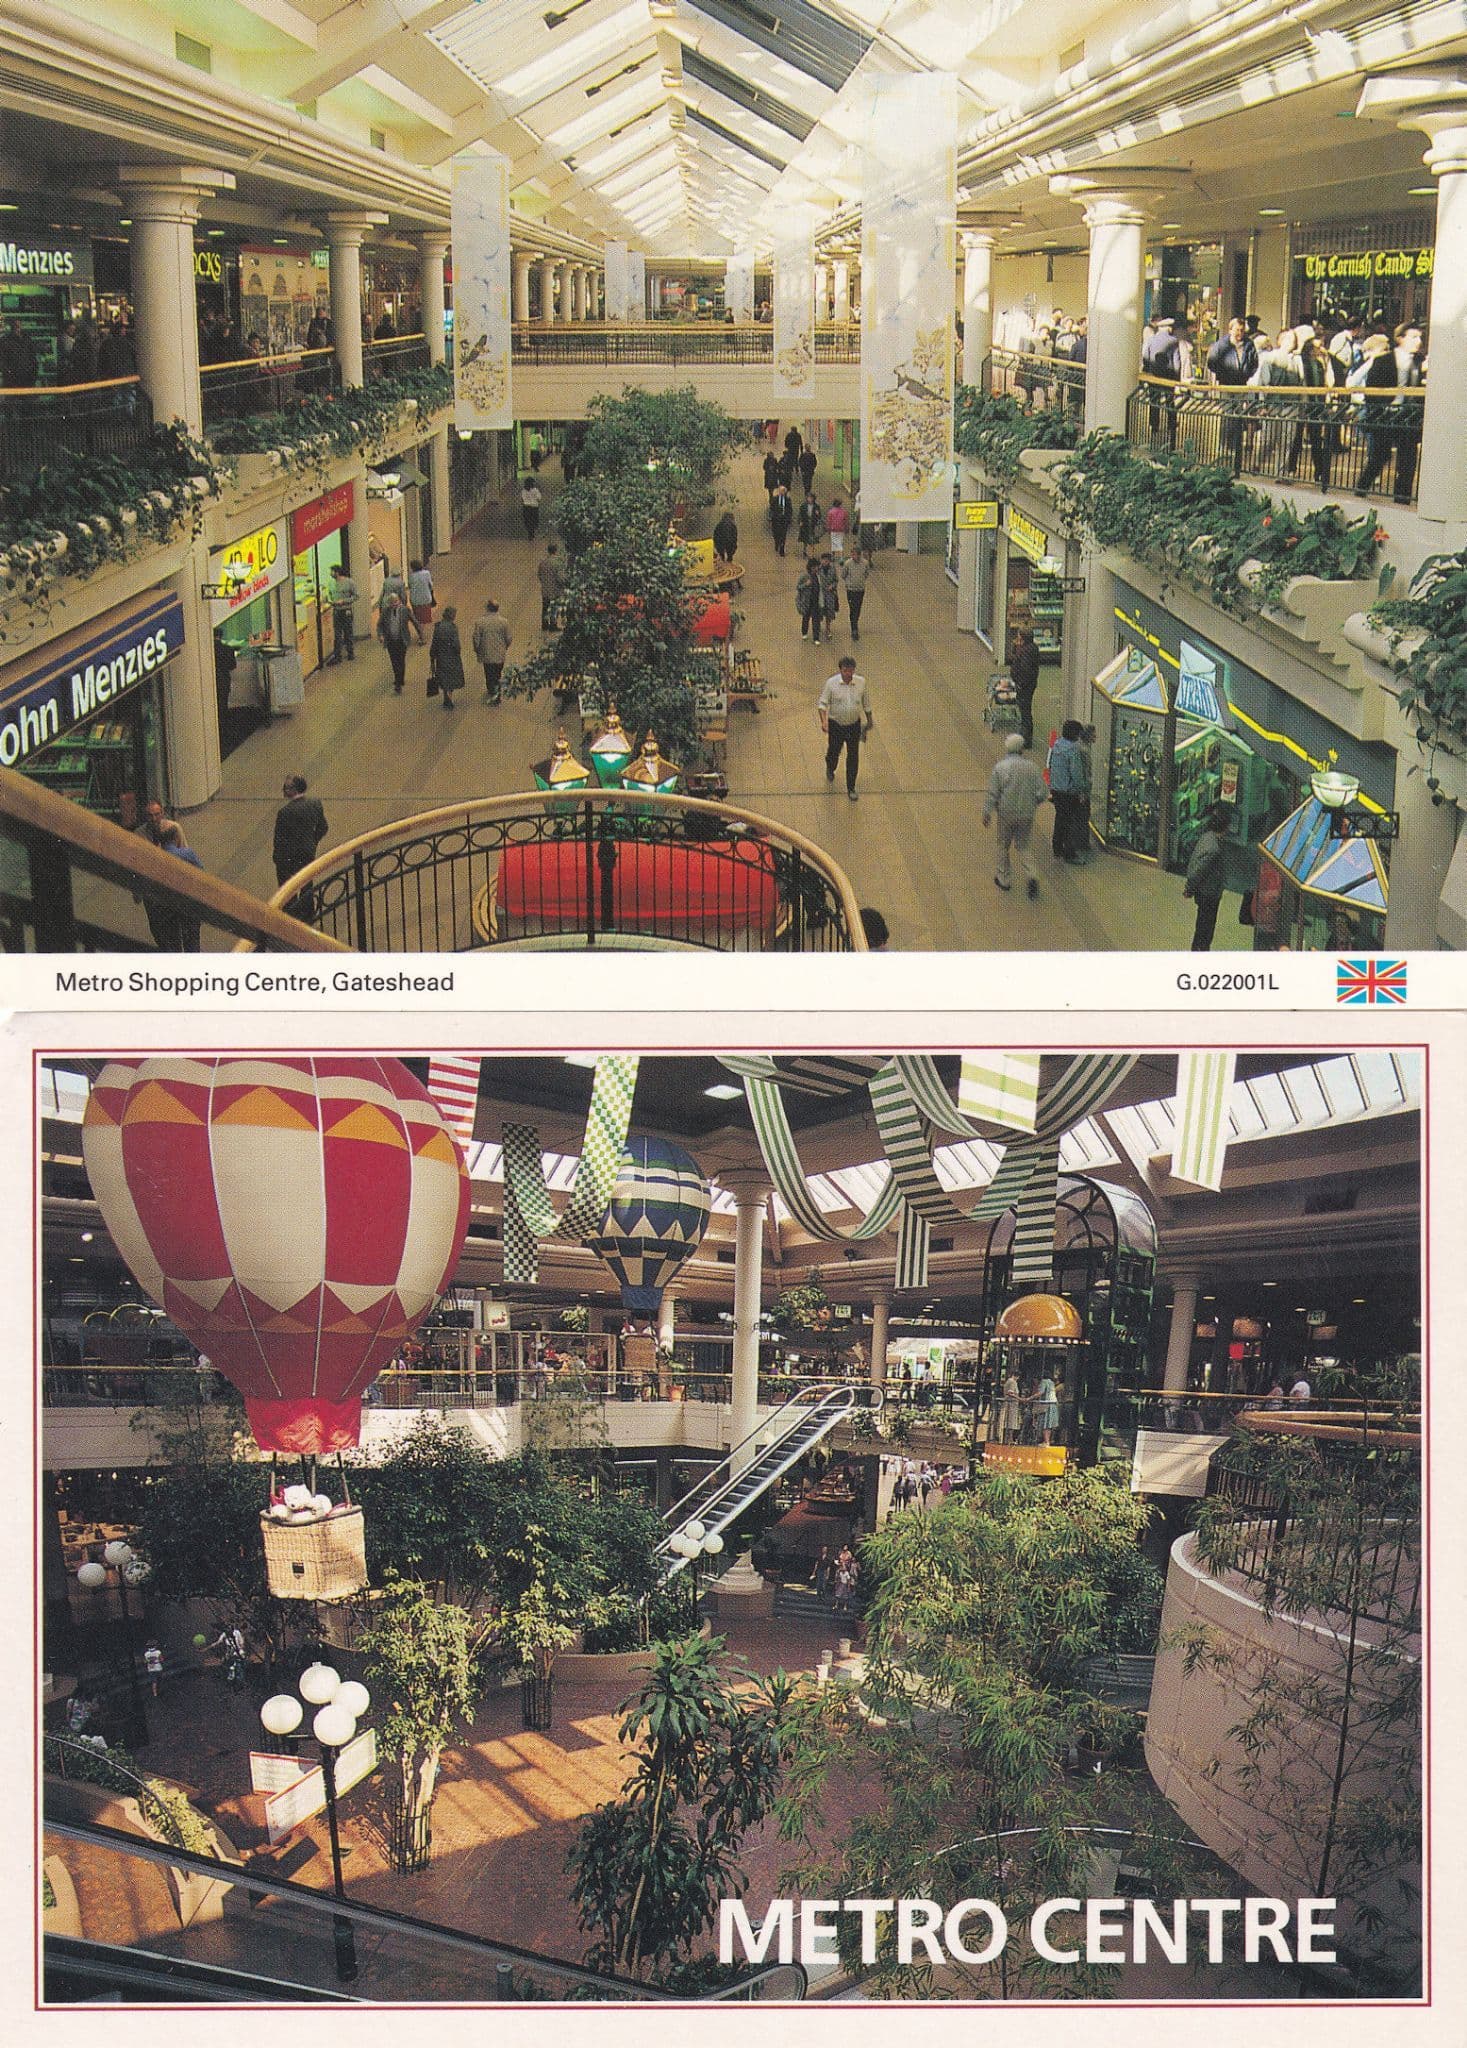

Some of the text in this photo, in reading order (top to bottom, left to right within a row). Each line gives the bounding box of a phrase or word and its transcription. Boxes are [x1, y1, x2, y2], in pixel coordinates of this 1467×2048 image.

[0, 242, 74, 275] Menzies
[1305, 254, 1327, 280] The
[1327, 251, 1372, 280] Cornish
[1374, 250, 1414, 279] Candy
[0, 628, 168, 766] ohn Menzies
[1176, 673, 1221, 722] STRAND
